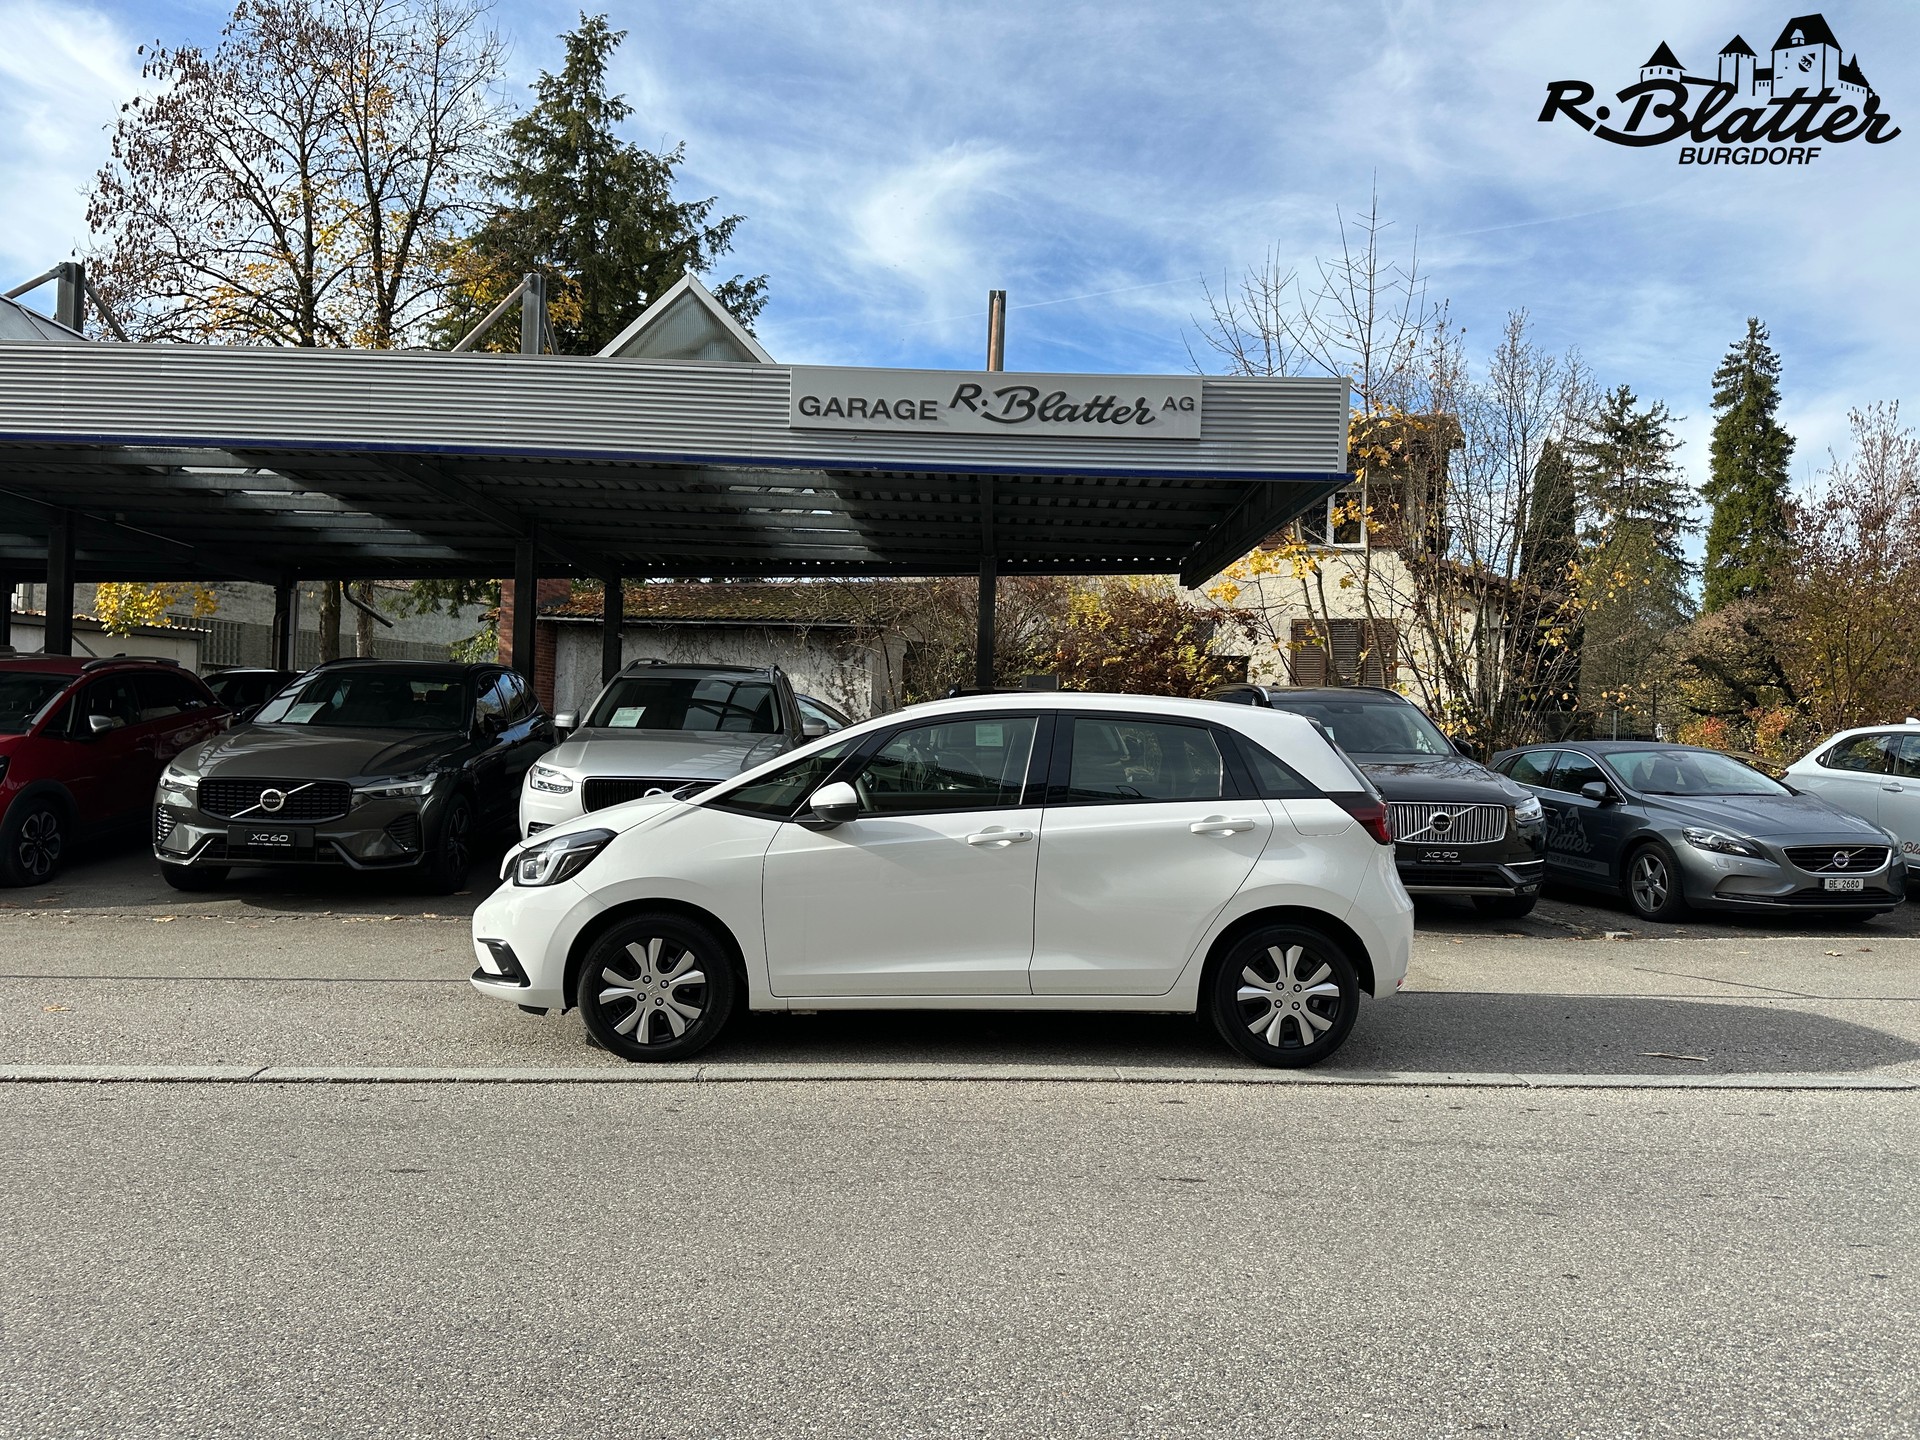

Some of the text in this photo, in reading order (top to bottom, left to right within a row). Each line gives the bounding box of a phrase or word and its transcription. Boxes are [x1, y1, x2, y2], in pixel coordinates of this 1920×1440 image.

[798, 395, 938, 421] GARAGE
[1161, 396, 1195, 412] AG
[1547, 828, 1592, 853] latter
